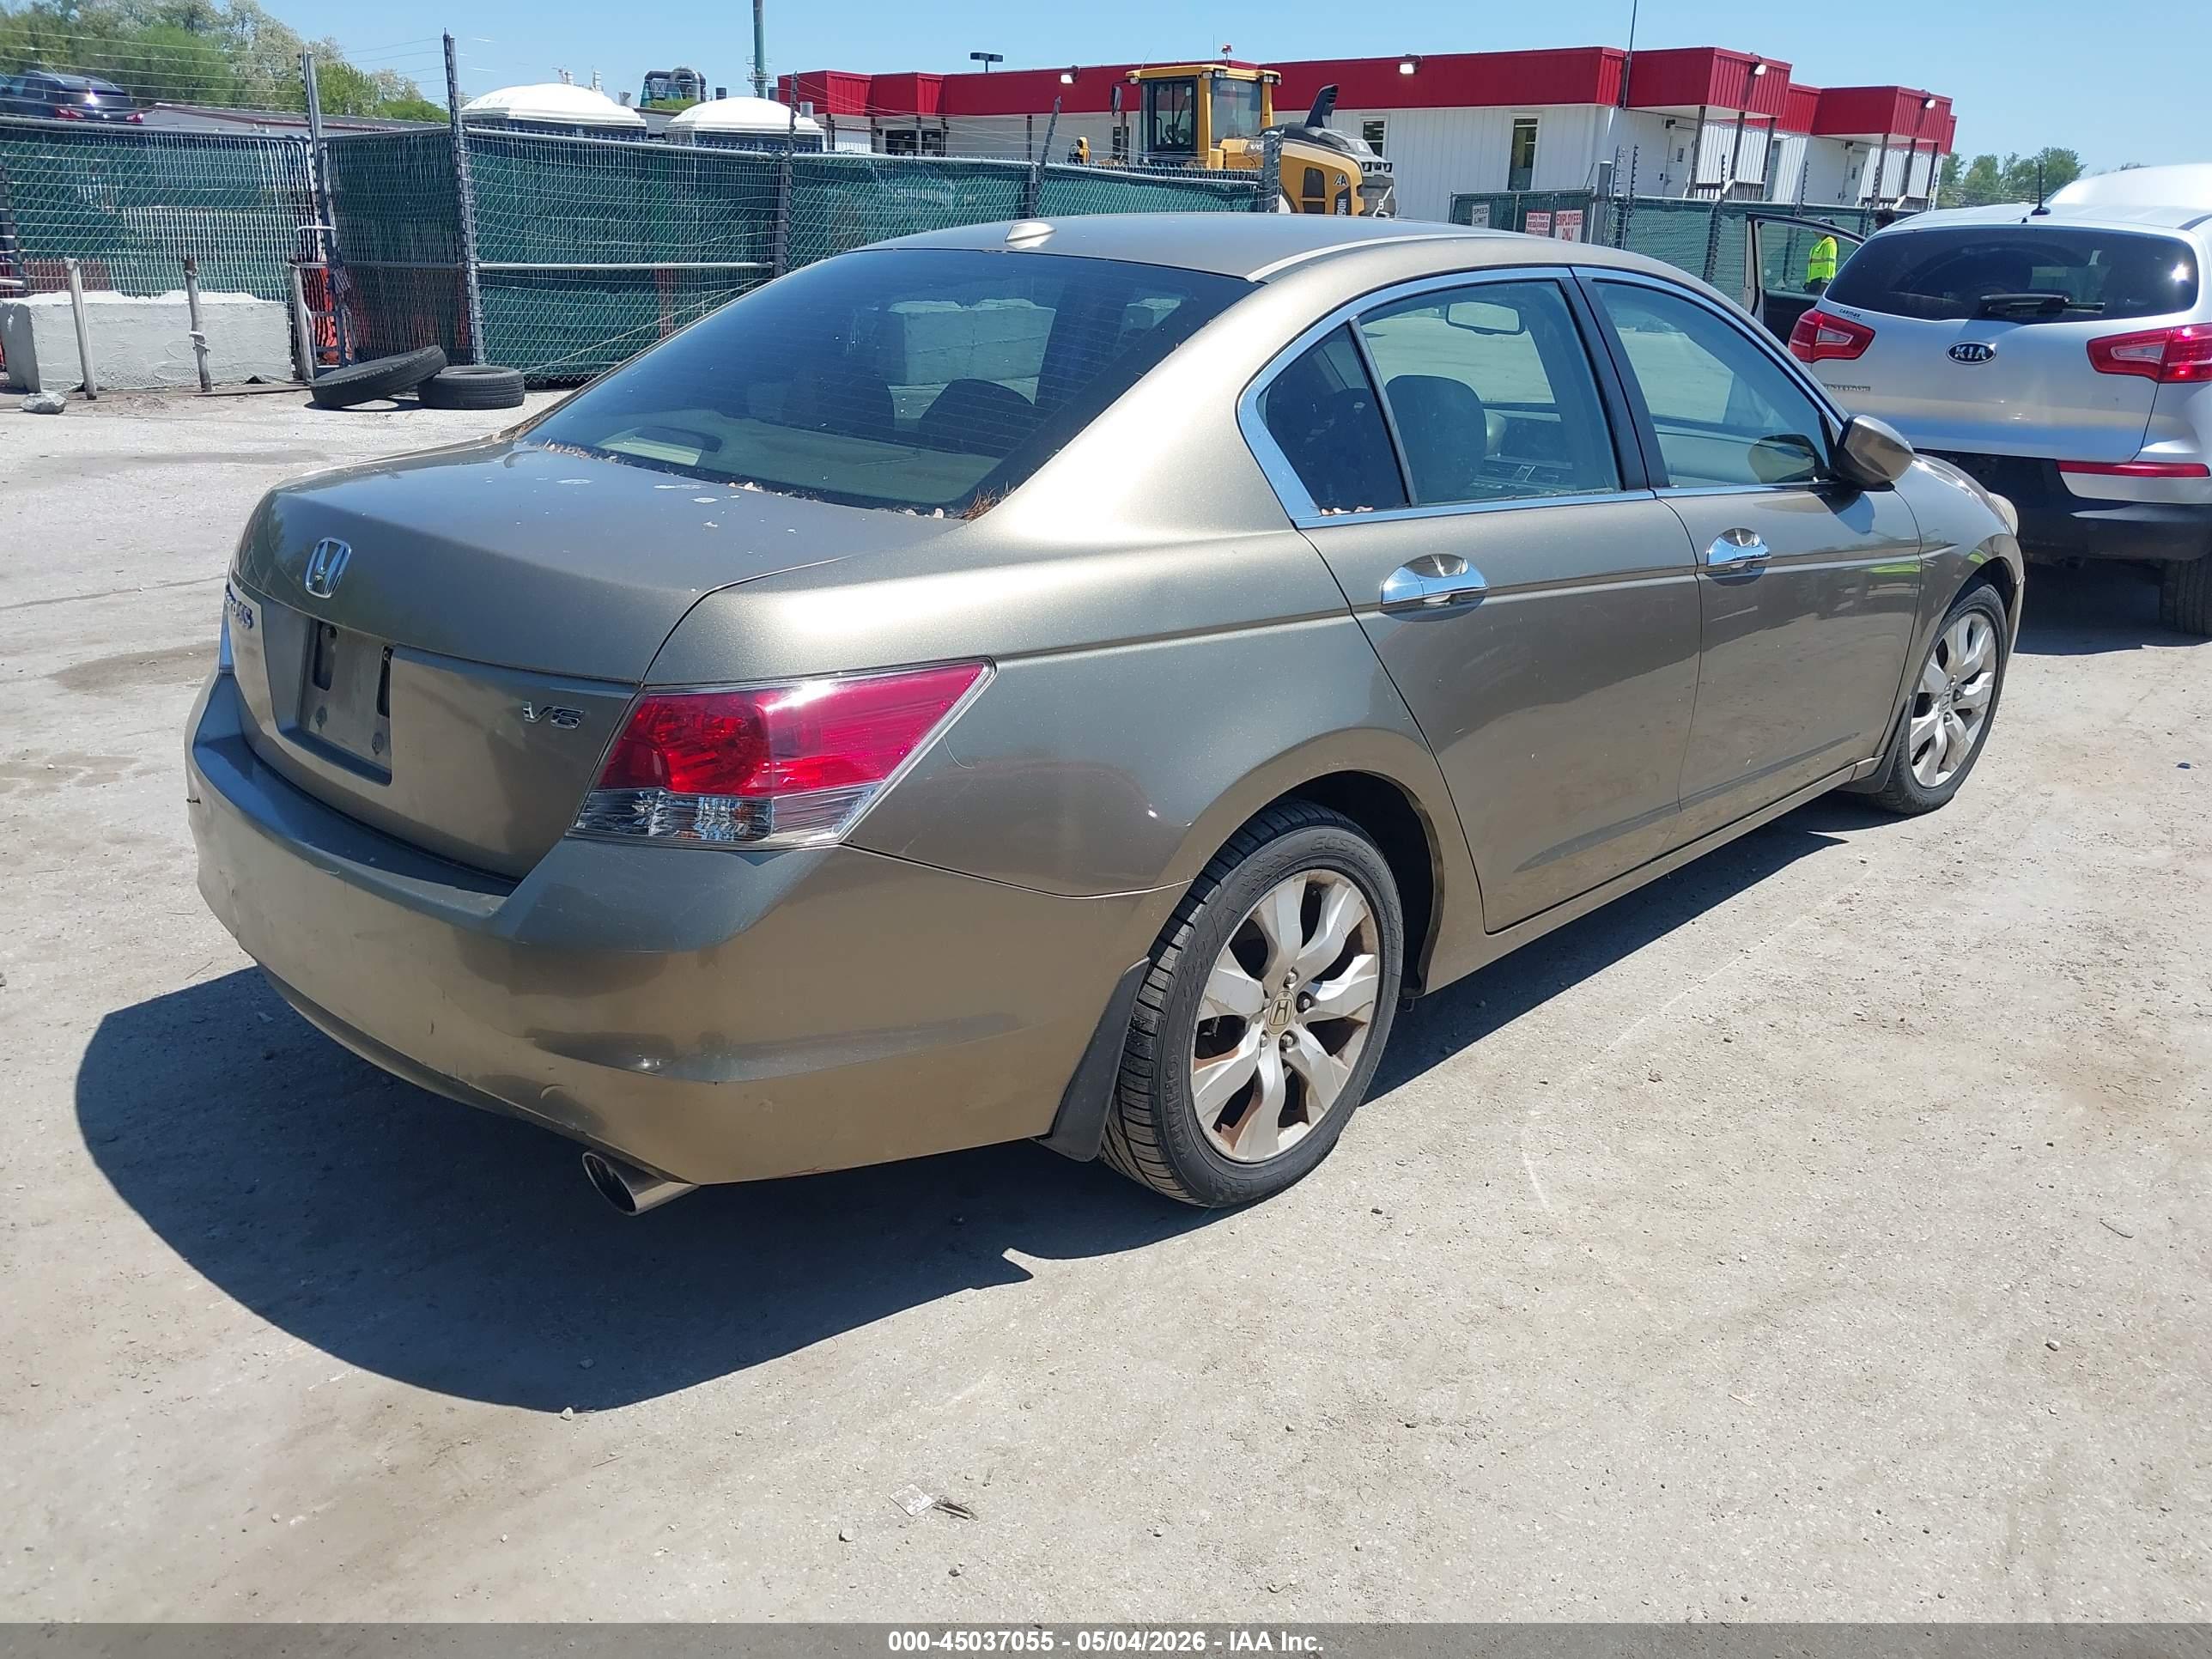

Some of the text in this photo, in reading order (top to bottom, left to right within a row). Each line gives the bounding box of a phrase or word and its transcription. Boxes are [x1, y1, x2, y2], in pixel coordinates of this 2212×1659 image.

[1556, 212, 1582, 227] EMPLOYEES
[1561, 227, 1574, 241] ONLY
[1954, 345, 1987, 360] KIA
[522, 701, 585, 729] V6
